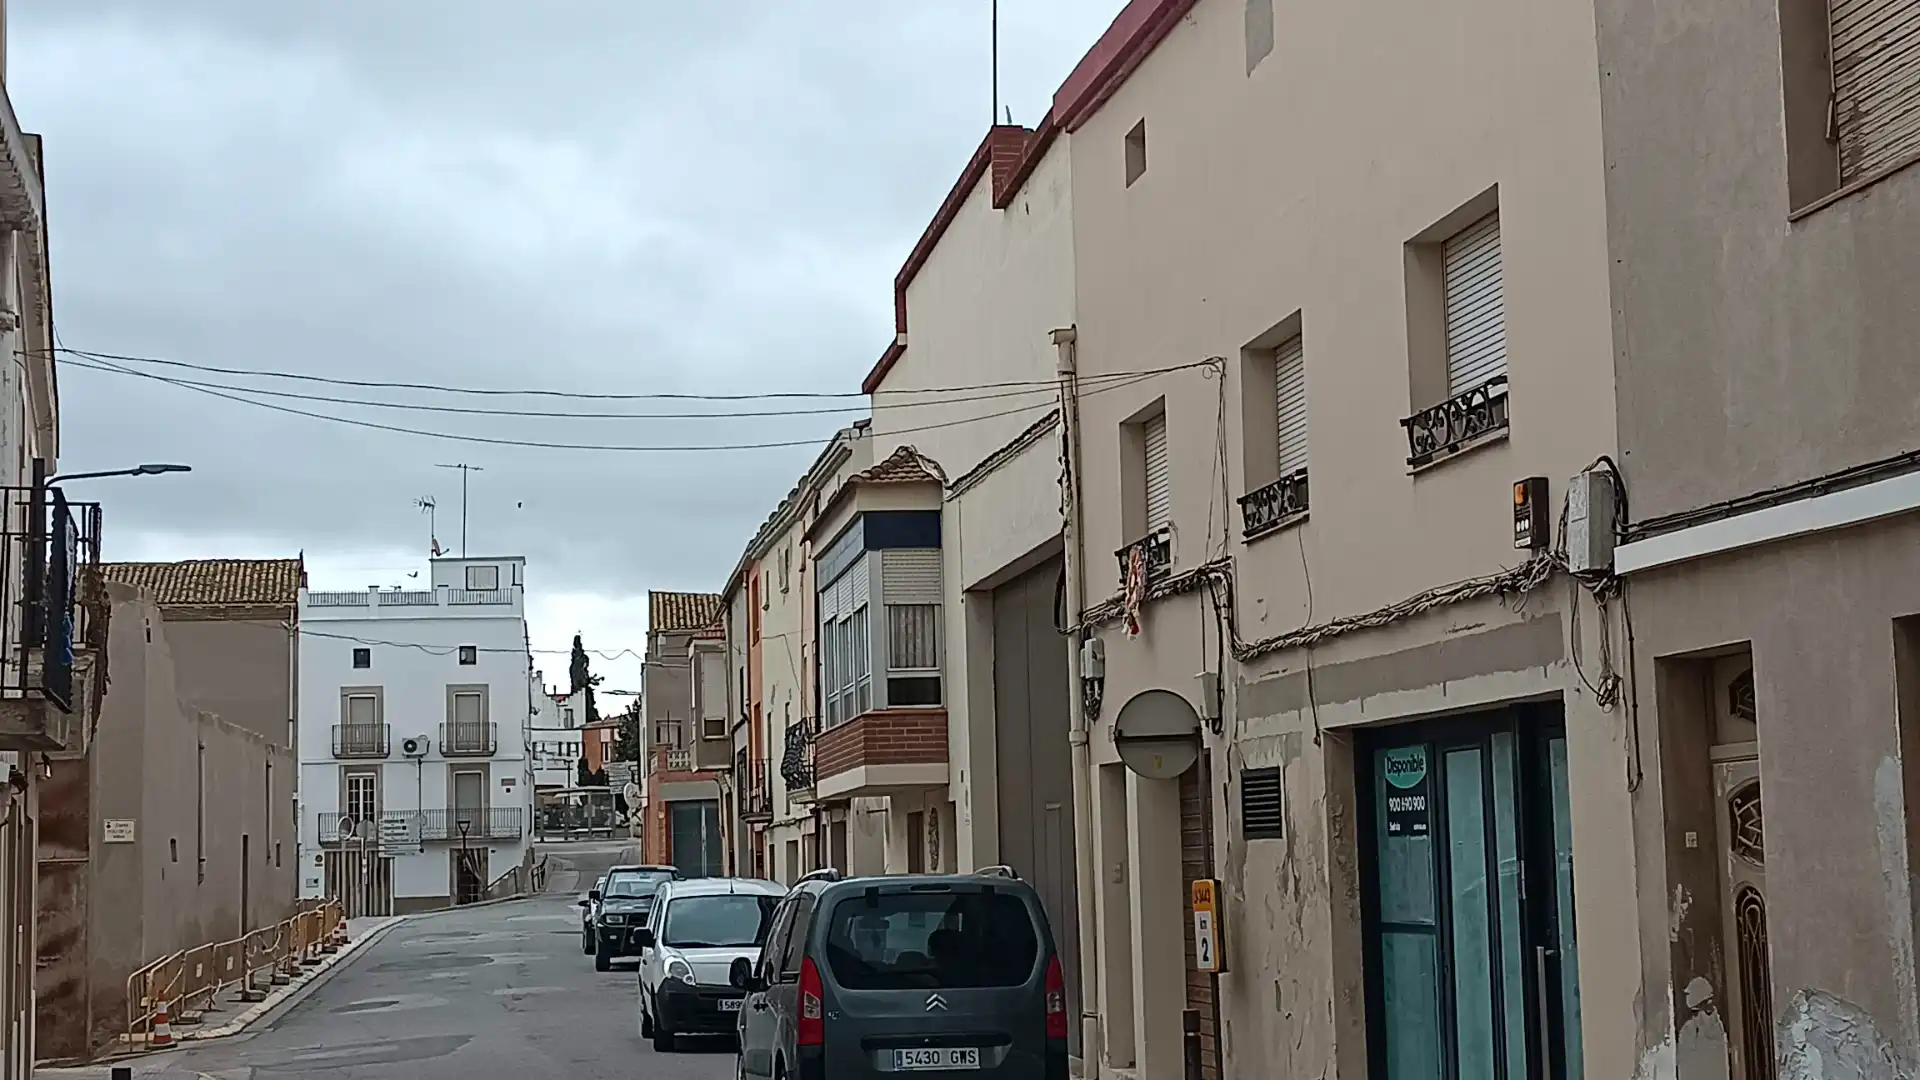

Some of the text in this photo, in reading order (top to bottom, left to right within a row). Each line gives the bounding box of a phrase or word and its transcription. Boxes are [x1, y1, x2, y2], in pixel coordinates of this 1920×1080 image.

[1386, 752, 1424, 777] Disponible
[1388, 797, 1401, 812] 900
[1413, 795, 1426, 811] 900
[1201, 937, 1209, 962] 2
[905, 1050, 977, 1065] 5430 GWS
